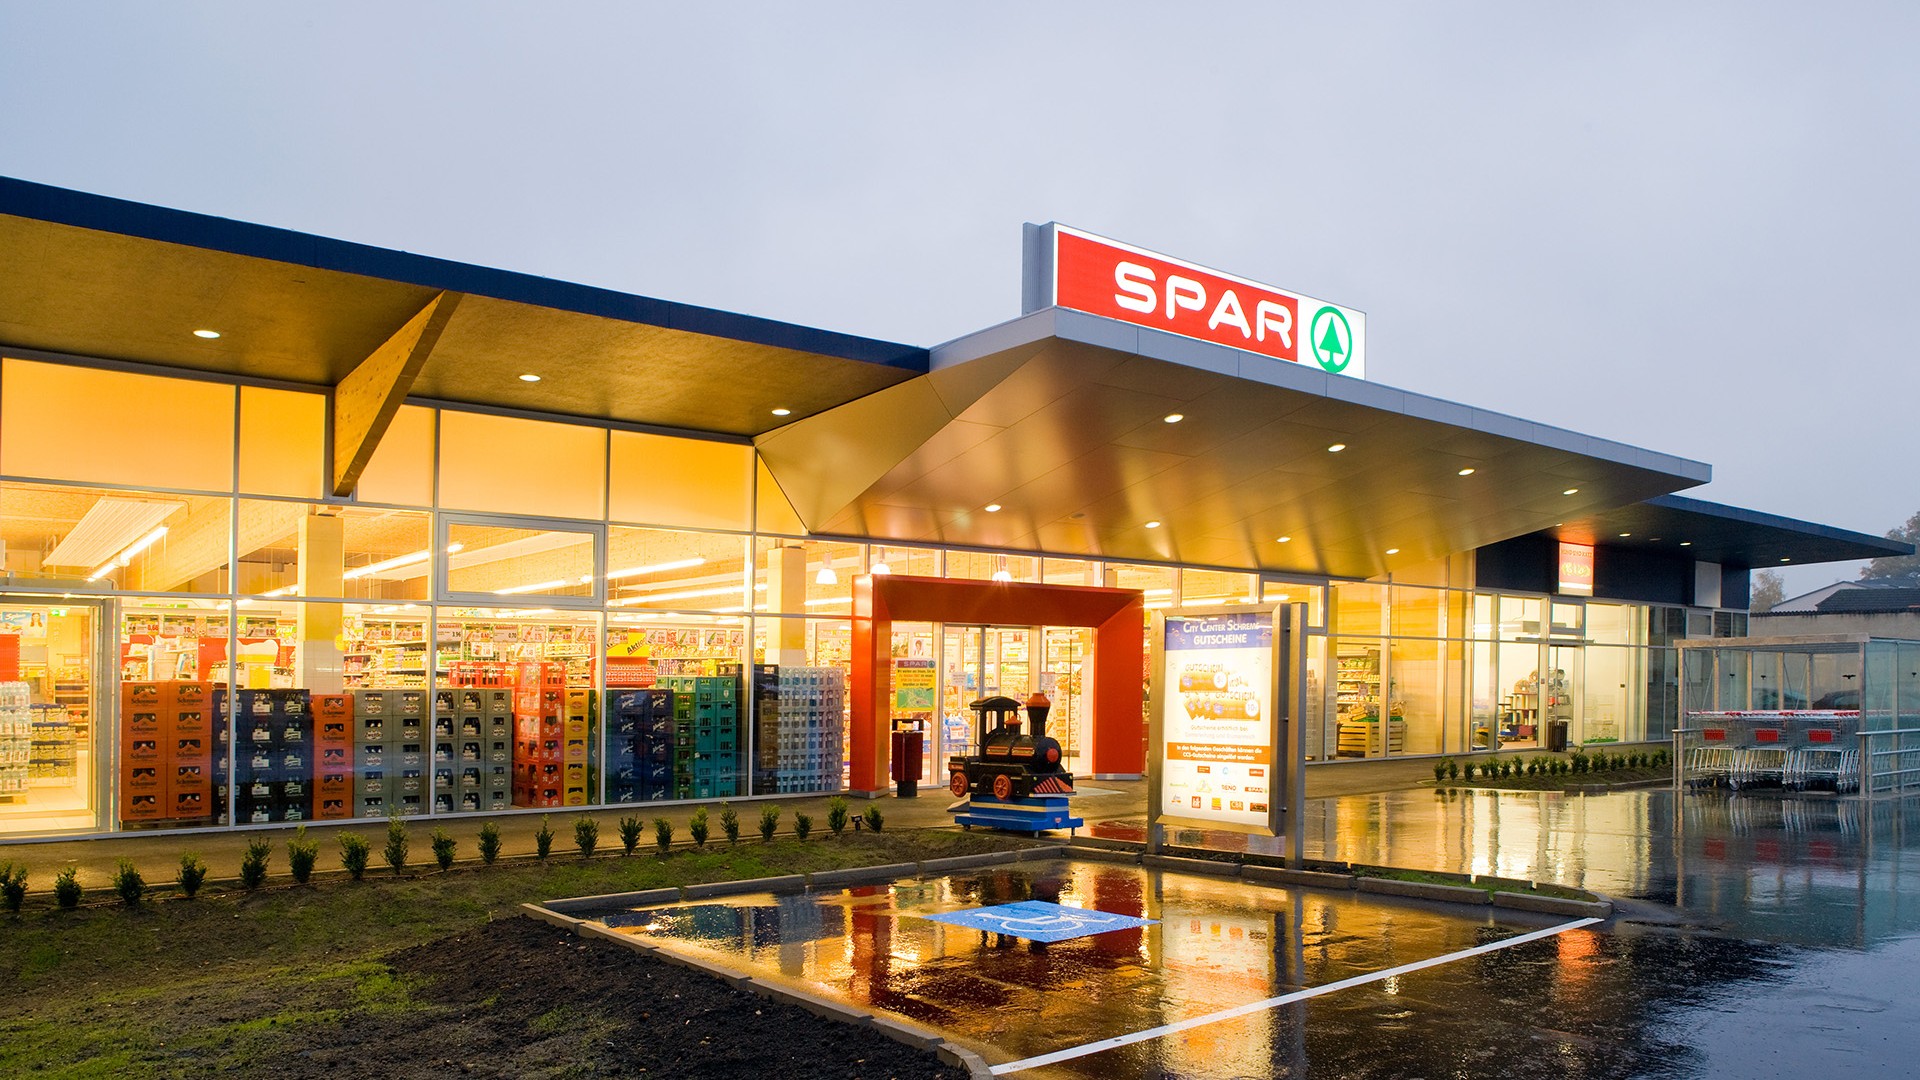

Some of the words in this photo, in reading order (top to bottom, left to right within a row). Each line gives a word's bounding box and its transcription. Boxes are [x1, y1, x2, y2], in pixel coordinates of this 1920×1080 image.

[1114, 260, 1293, 349] SPAR
[1183, 622, 1199, 633] CITY
[1200, 621, 1225, 633] CENTER
[1193, 634, 1248, 646] GUTSCHEINE
